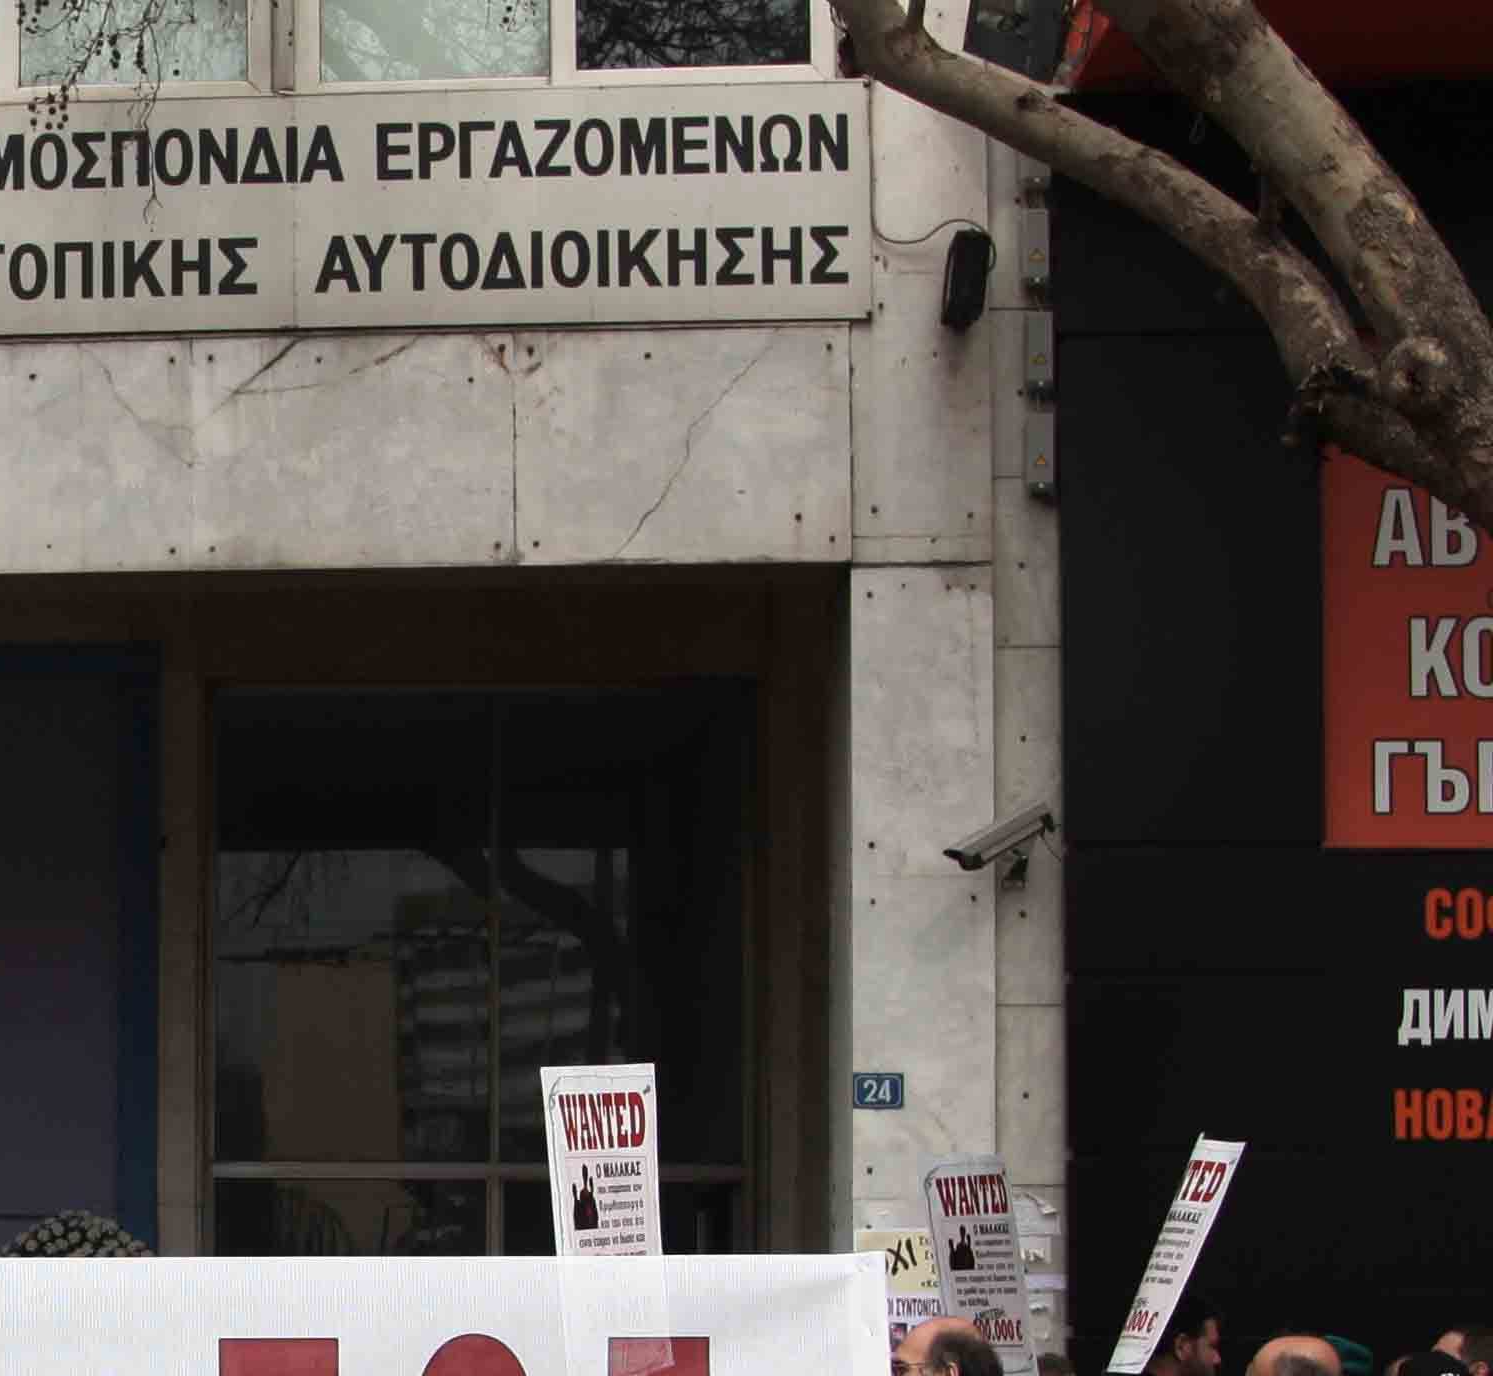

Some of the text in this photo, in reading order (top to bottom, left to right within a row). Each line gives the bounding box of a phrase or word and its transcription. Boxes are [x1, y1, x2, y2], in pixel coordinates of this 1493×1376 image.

[376, 113, 849, 181] ΕΡΓΑΖΟΜΕΝΩΝ
[315, 225, 849, 295] ΑΥΤΟΔΙΟΙΚΗΣΗΣ
[1424, 888, 1493, 940] СО
[864, 1079, 892, 1104] 24
[1394, 1088, 1493, 1140] НОВ
[558, 1091, 647, 1152] WANTED
[936, 1174, 1009, 1217] WANTED
[1179, 1160, 1227, 1202] TED
